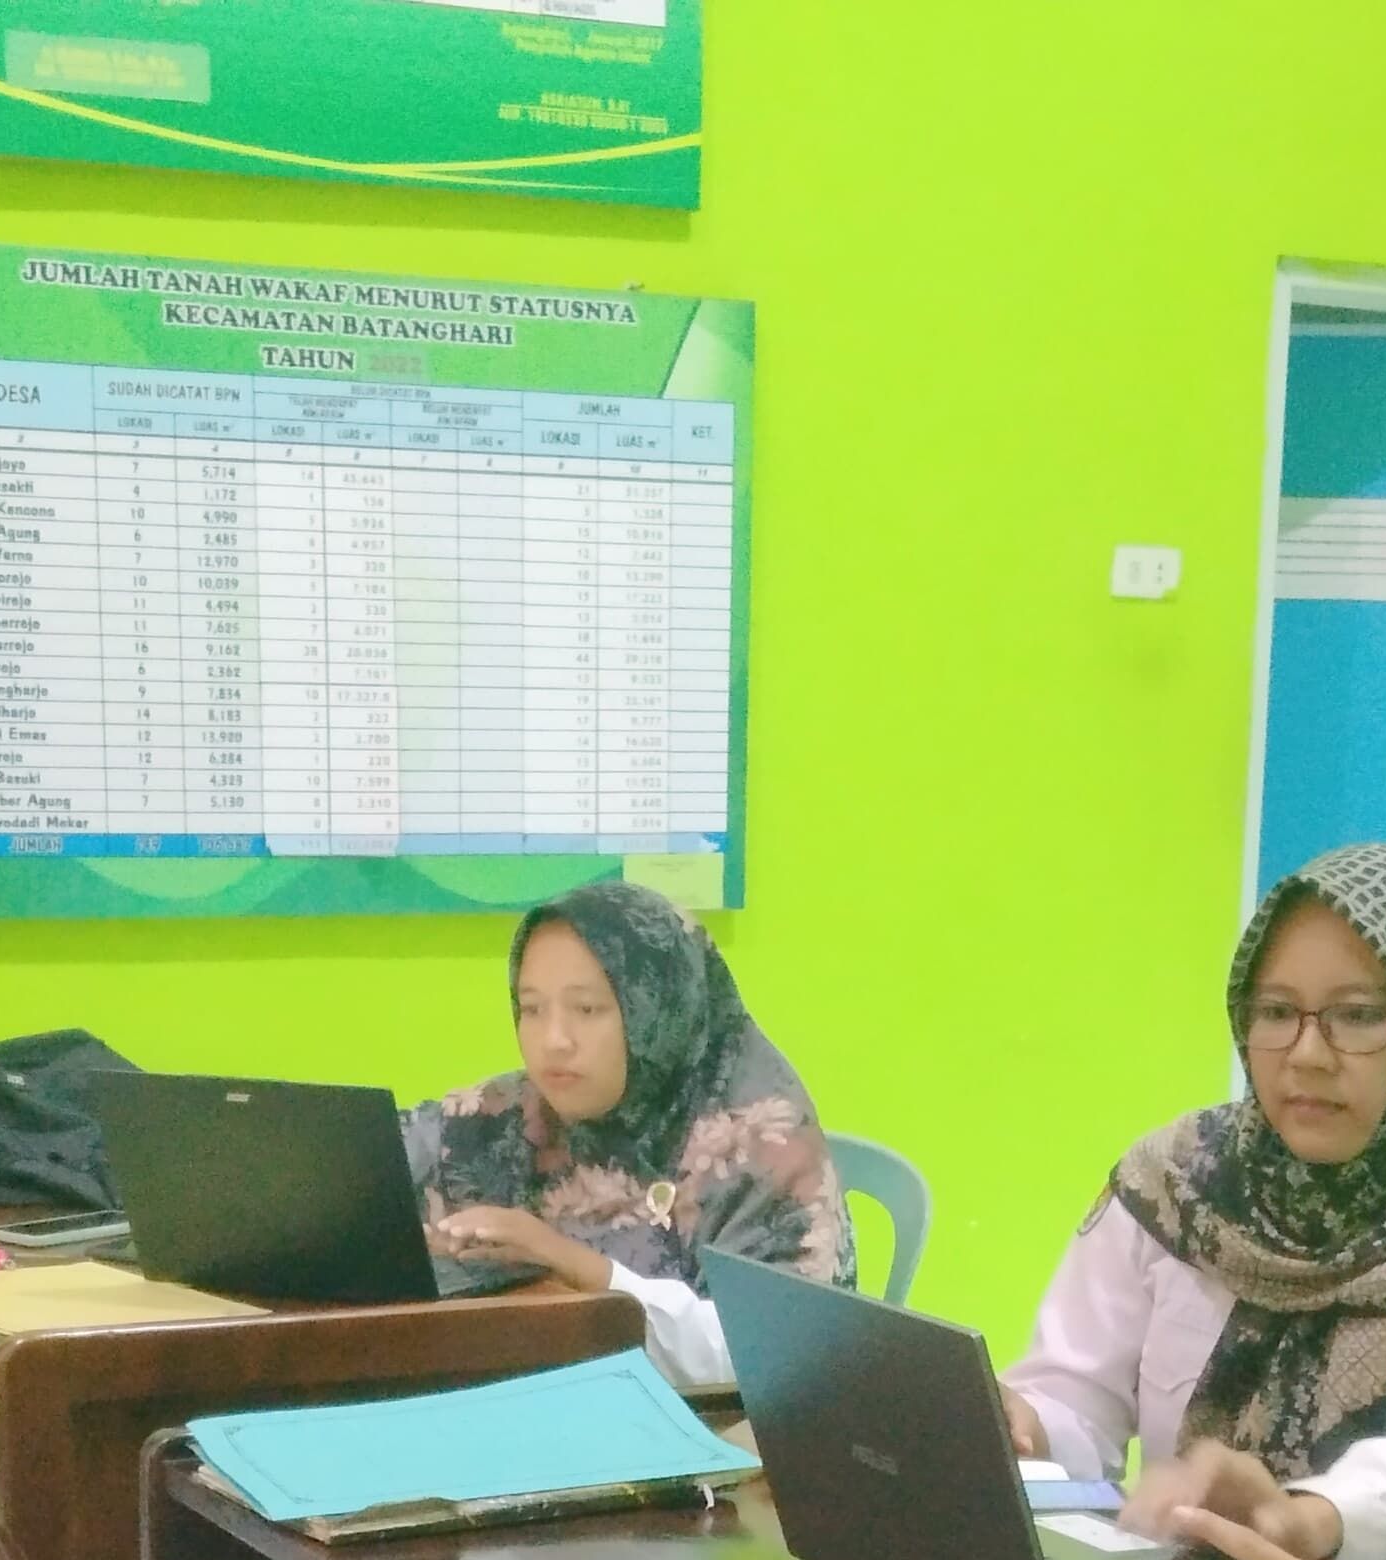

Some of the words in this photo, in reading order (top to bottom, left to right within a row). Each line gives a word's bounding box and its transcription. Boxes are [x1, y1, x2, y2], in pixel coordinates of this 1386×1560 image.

[22, 261, 139, 289] JUMLAH
[147, 270, 243, 296] TANAH
[250, 279, 347, 301] WAKAF
[356, 285, 479, 313] MENURUT
[489, 297, 635, 323] STATUSNYA
[163, 303, 334, 334] KECAMATAN
[342, 318, 513, 345] BATANGHARI
[262, 347, 355, 370] TAHUN
[109, 382, 151, 397] SUDAH
[157, 385, 210, 400] DICATAT
[215, 388, 240, 401] BPN
[579, 403, 620, 416] JUMLAH
[541, 431, 580, 445] LOKASI
[616, 436, 643, 447] LUAS
[133, 462, 138, 472] 7
[134, 486, 140, 497] 4
[131, 509, 144, 520] 10
[134, 530, 141, 542] 6
[135, 553, 141, 564] 7
[133, 576, 146, 588] 10
[134, 598, 145, 608] 11
[135, 622, 145, 632] 11
[135, 643, 149, 654] 16
[138, 664, 145, 675] 6
[139, 686, 145, 698] 9
[137, 709, 150, 720] 14
[137, 731, 151, 742] 12
[138, 752, 151, 764] 12
[141, 774, 147, 785] 7
[142, 796, 148, 808] 7
[11, 834, 62, 850] JUMLAH
